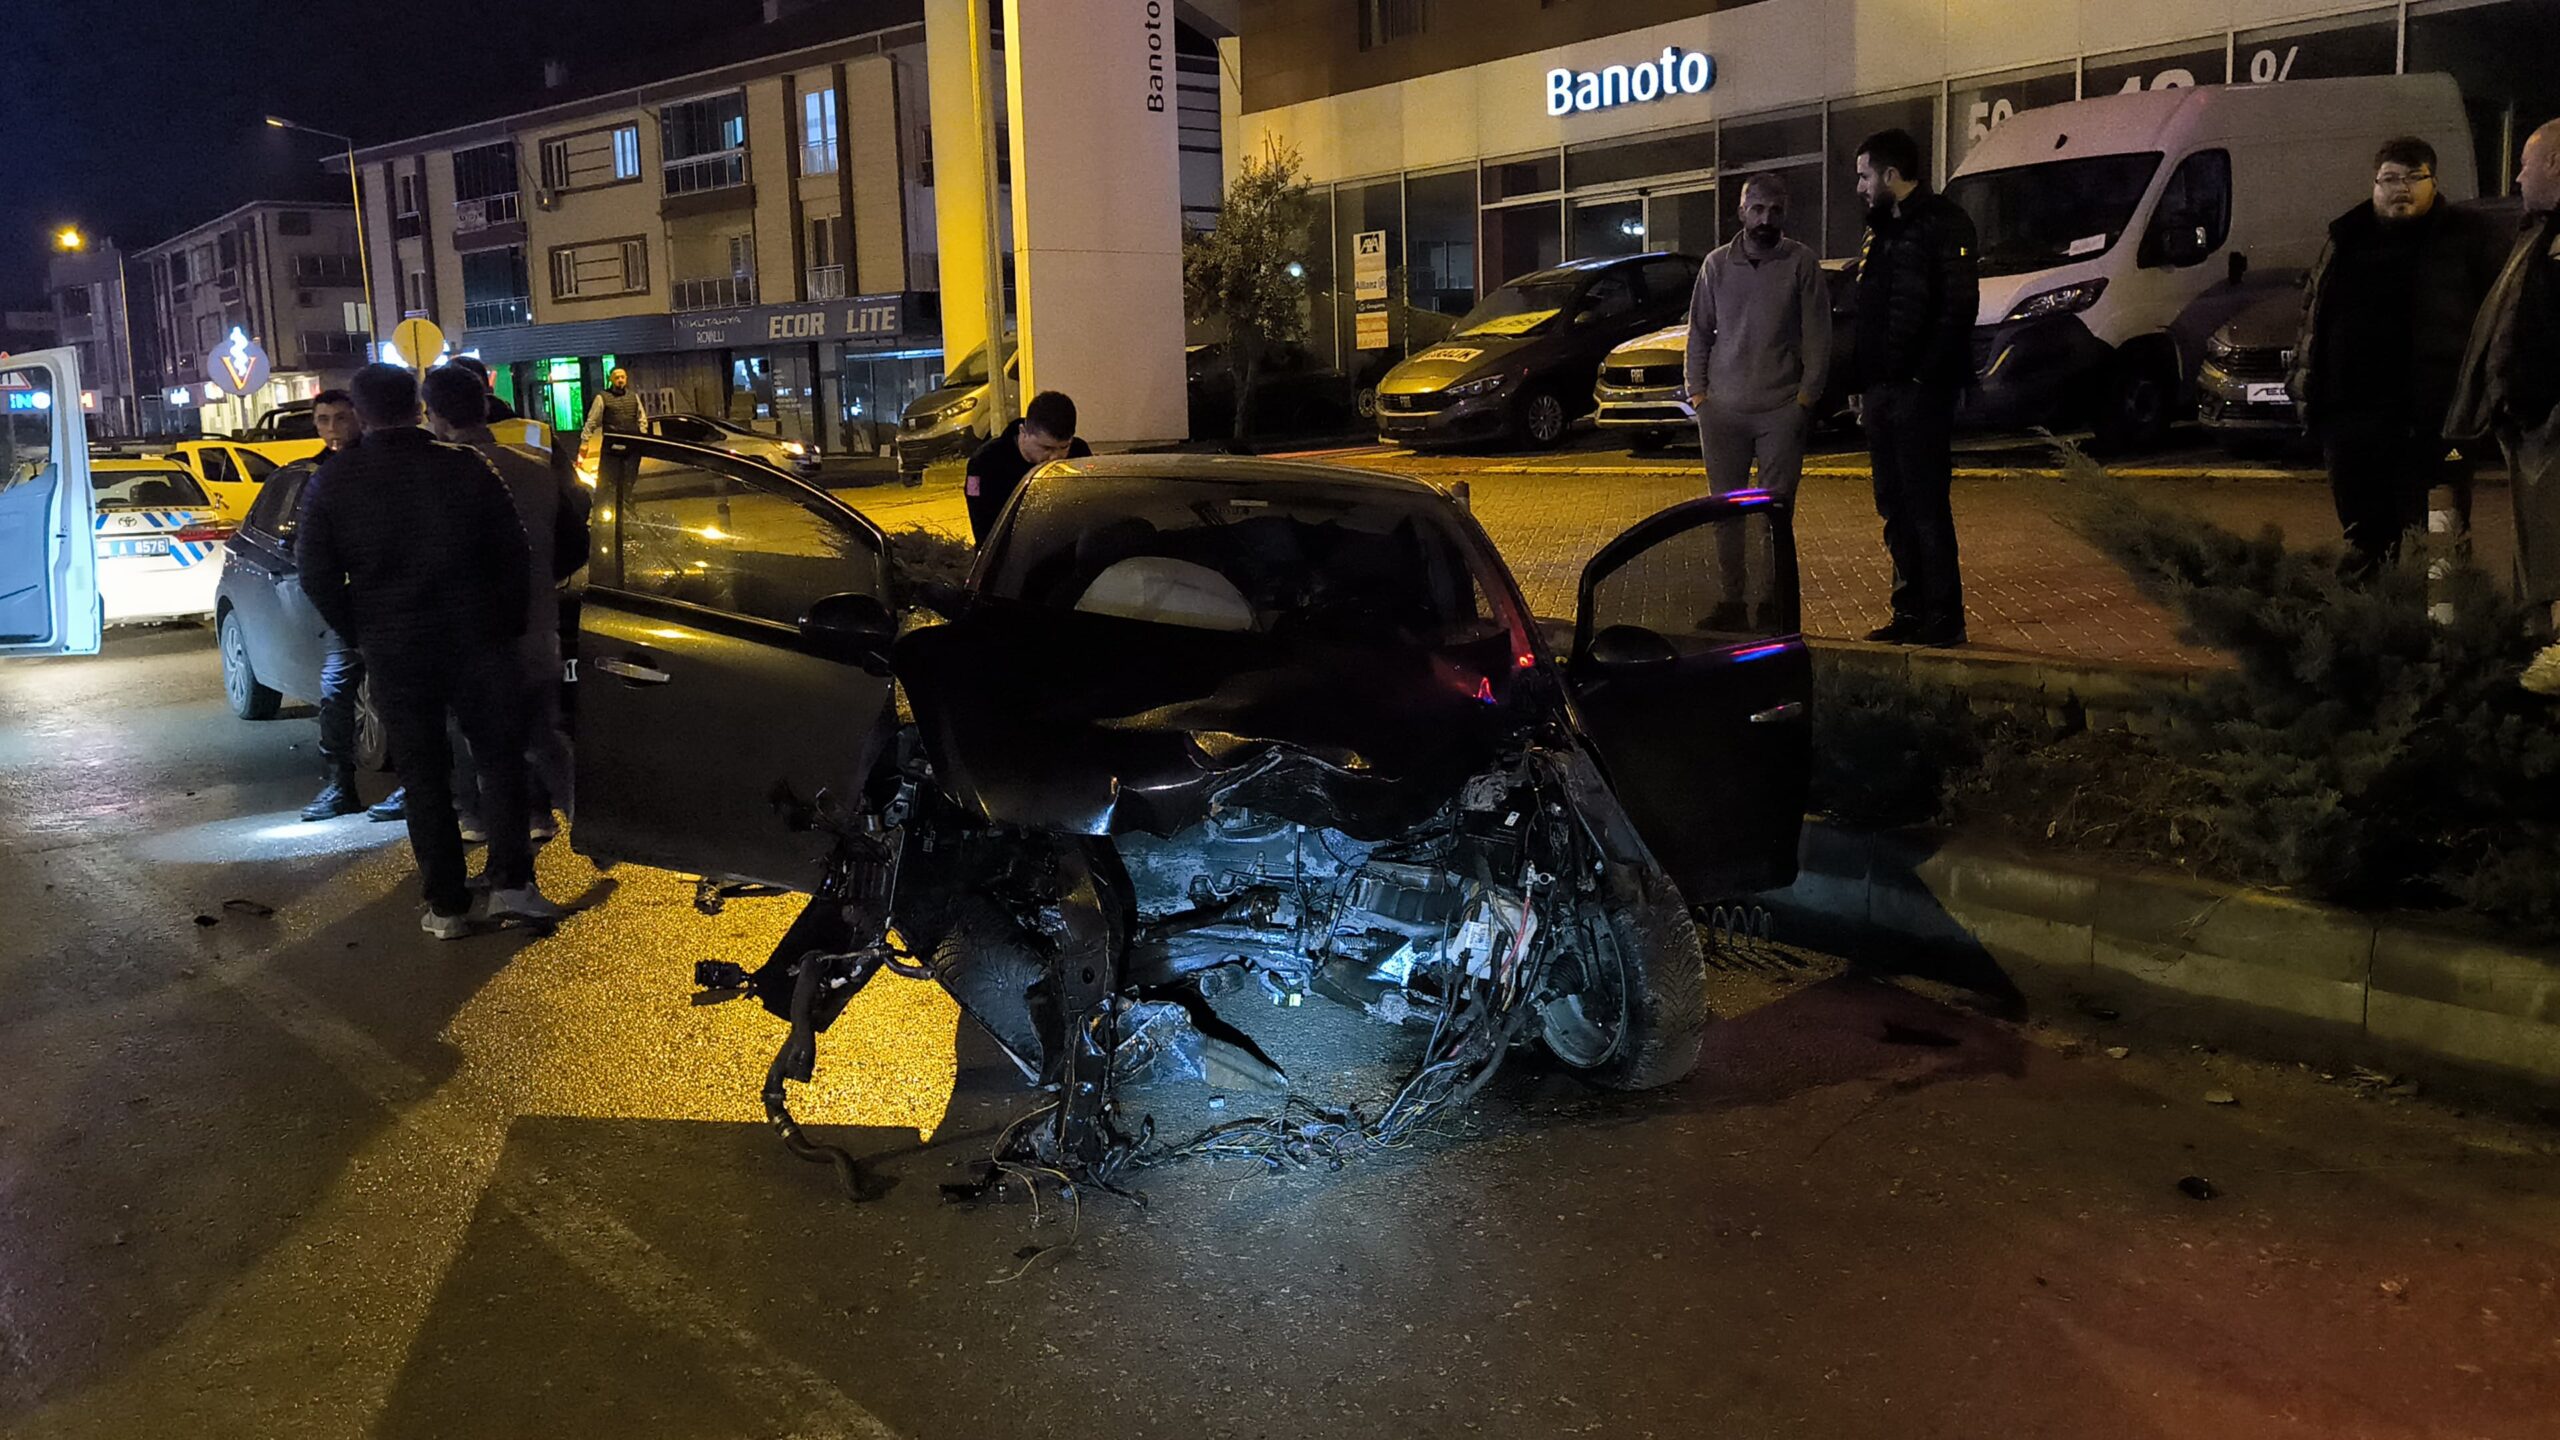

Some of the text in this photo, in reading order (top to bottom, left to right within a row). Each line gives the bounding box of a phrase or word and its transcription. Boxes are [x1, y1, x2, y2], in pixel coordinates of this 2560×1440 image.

[1145, 1, 1164, 112] Banoto
[1546, 46, 1711, 116] Banoto
[768, 312, 826, 340] ECOR
